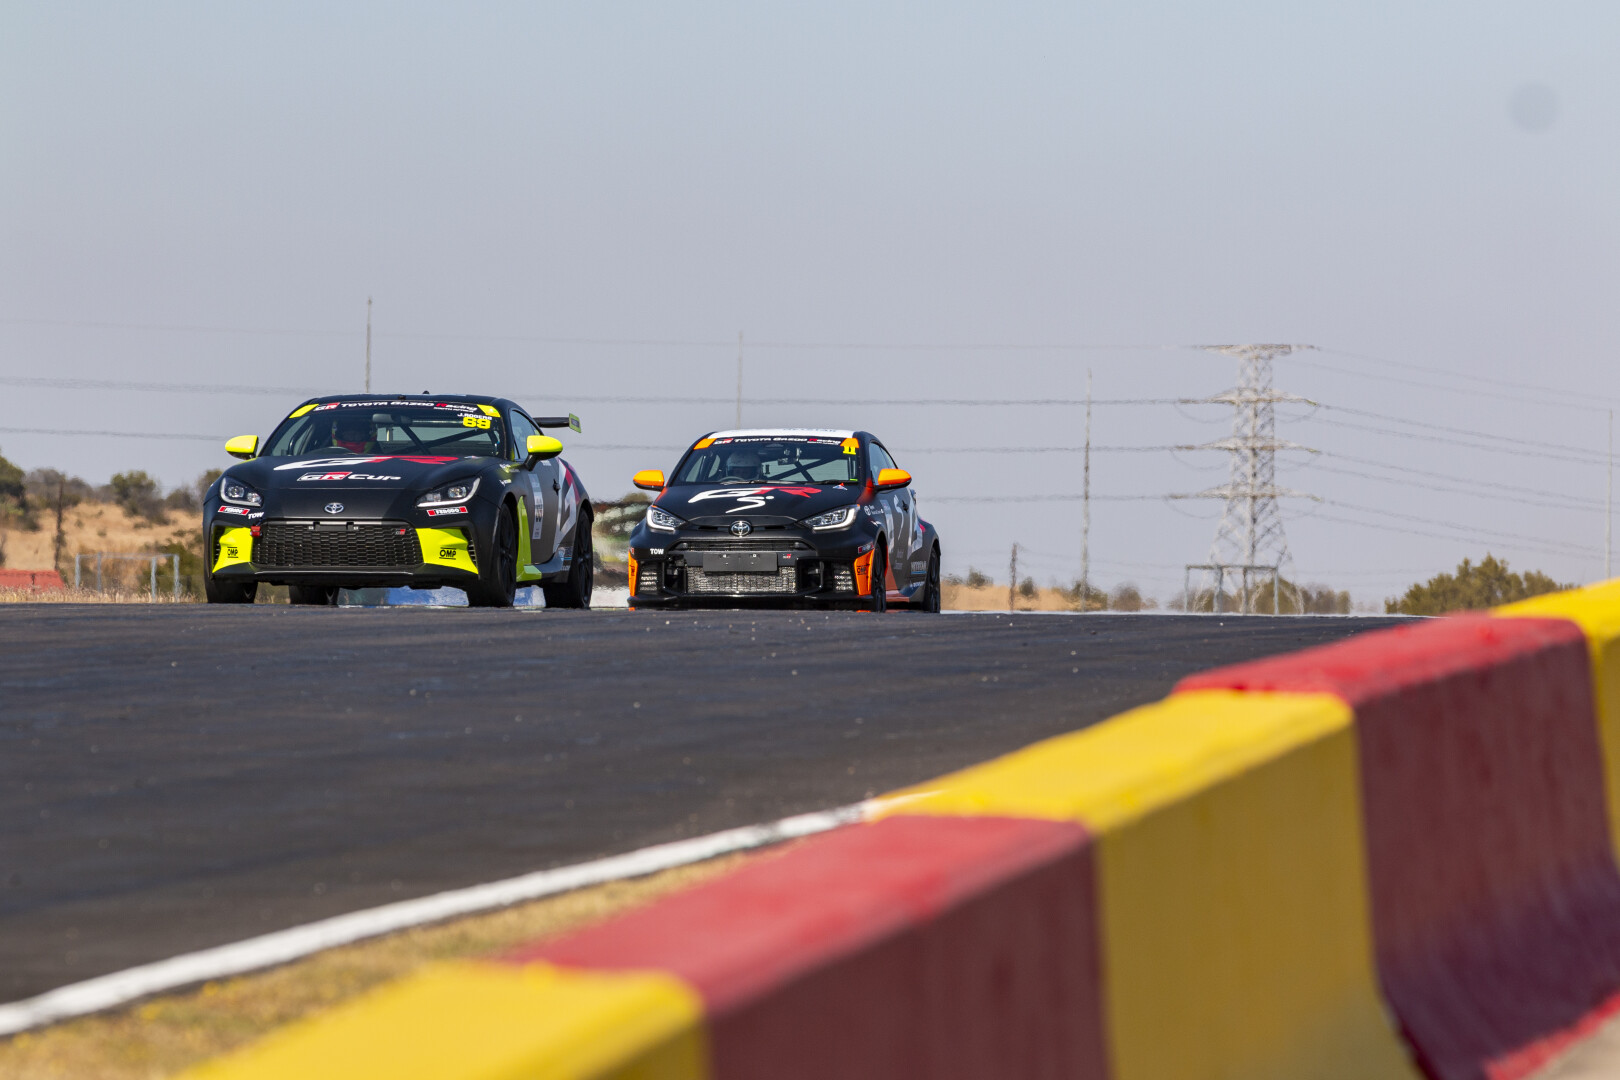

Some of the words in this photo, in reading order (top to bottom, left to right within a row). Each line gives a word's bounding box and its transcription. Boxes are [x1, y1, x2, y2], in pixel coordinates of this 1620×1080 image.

[313, 402, 340, 411] GR
[297, 471, 352, 481] GR
[248, 512, 265, 520] TOW
[439, 549, 457, 558] OMP
